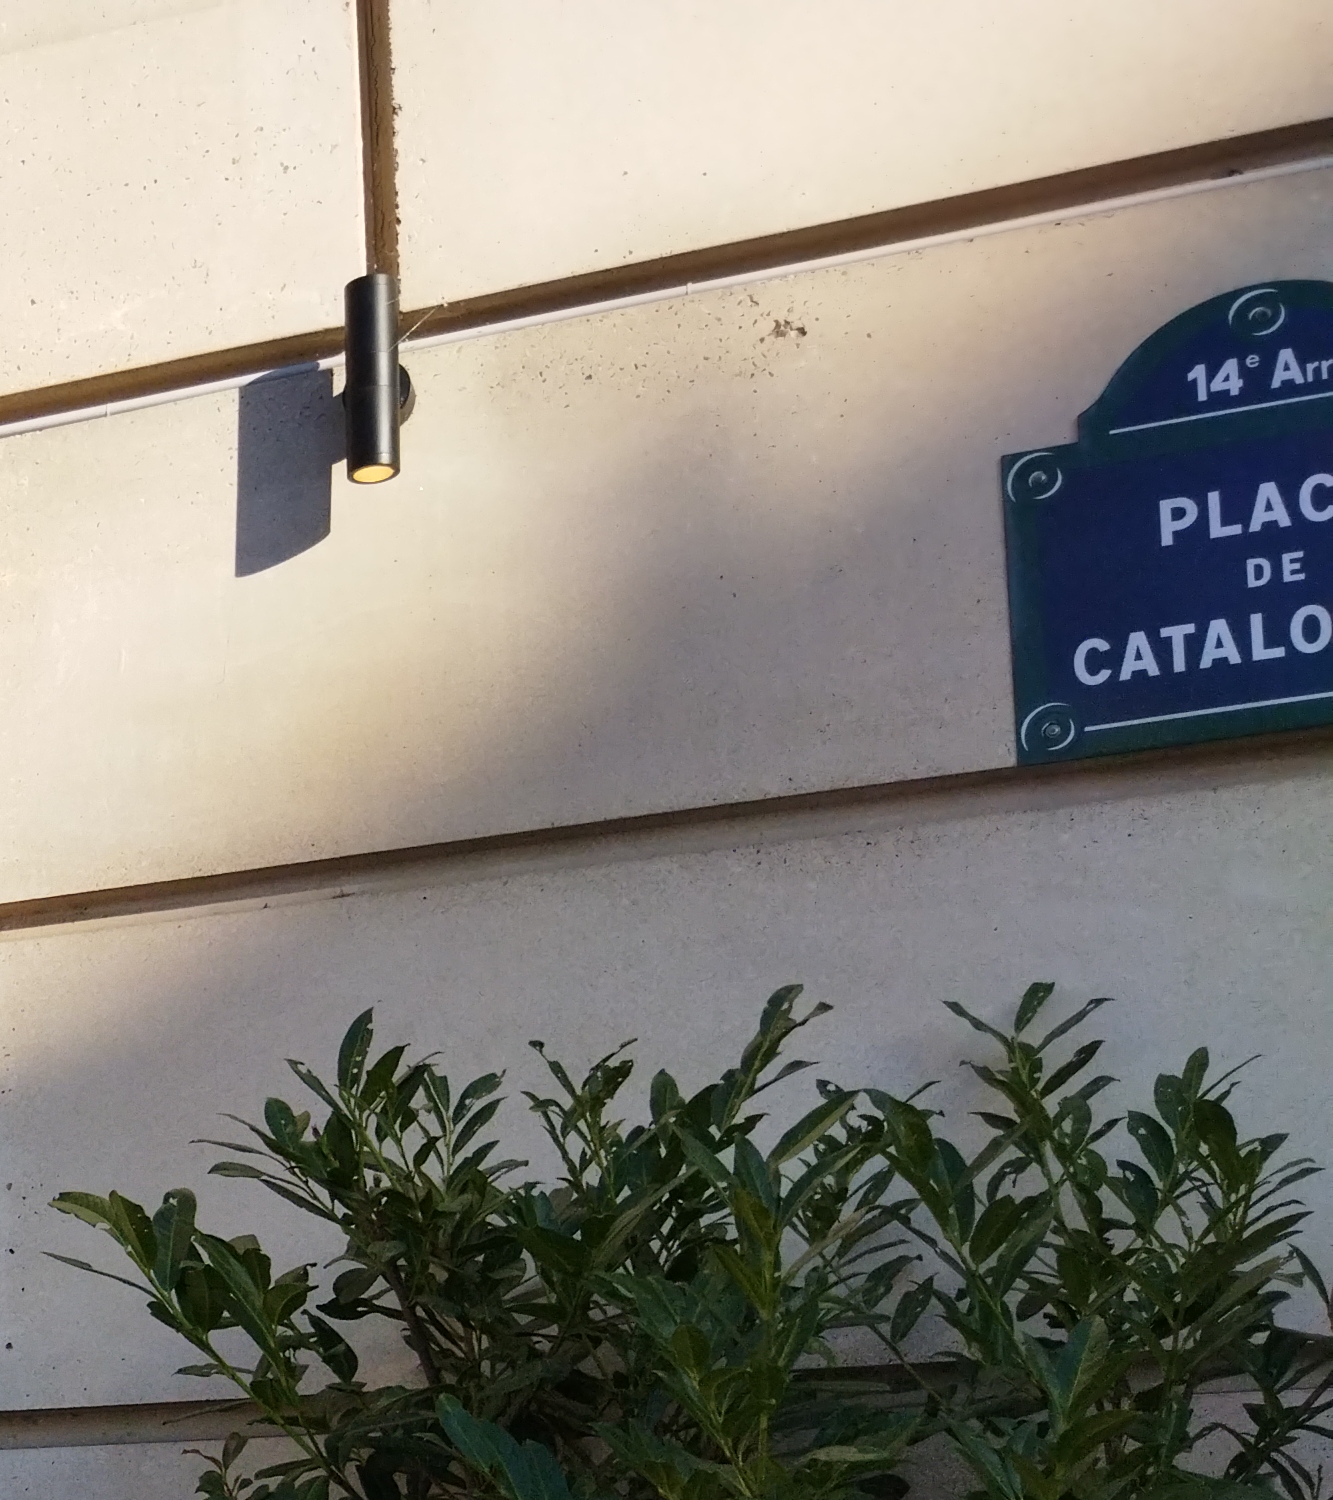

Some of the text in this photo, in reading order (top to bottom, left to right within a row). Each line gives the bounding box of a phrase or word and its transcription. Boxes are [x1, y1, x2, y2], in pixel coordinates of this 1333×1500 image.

[1158, 472, 1333, 547] PLAC
[1245, 550, 1306, 589] DE
[1072, 603, 1333, 687] CATALO
